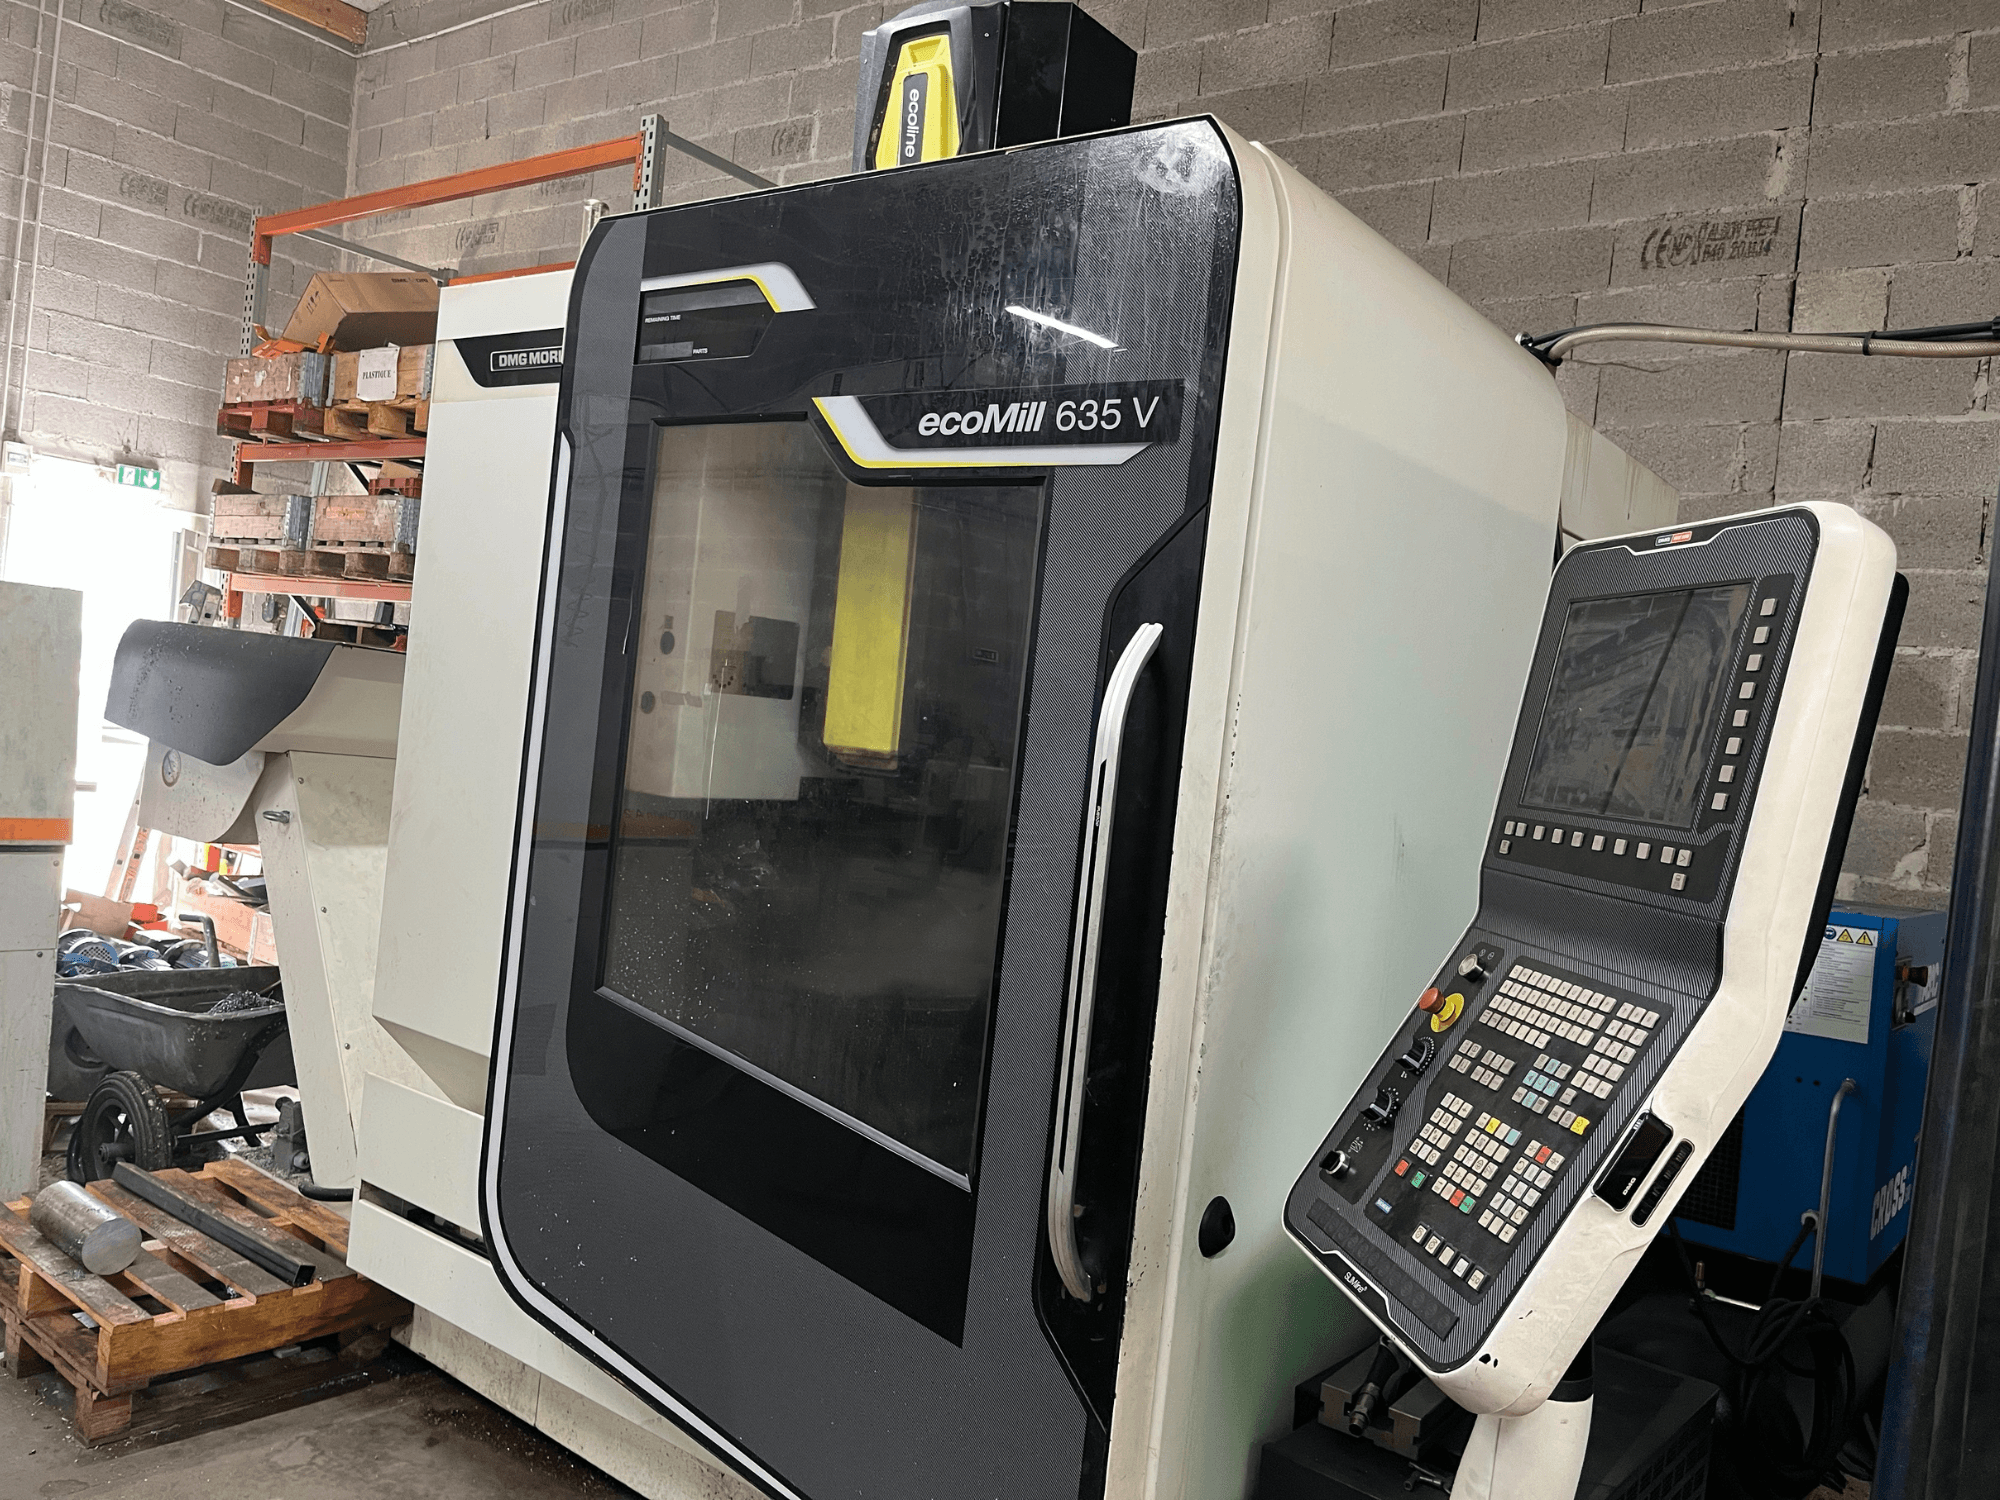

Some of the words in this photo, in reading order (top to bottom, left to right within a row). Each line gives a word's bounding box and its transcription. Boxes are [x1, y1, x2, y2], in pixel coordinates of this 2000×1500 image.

[905, 89, 919, 158] ecoline
[644, 316, 670, 324] REMAINING
[498, 352, 528, 367] DMG
[529, 350, 563, 365] MORI
[362, 370, 392, 380] PLASTIQUE
[918, 401, 1047, 436] ecoMill
[1056, 399, 1122, 432] 635
[1133, 396, 1160, 428] V
[1870, 1164, 1908, 1241] CROSS
